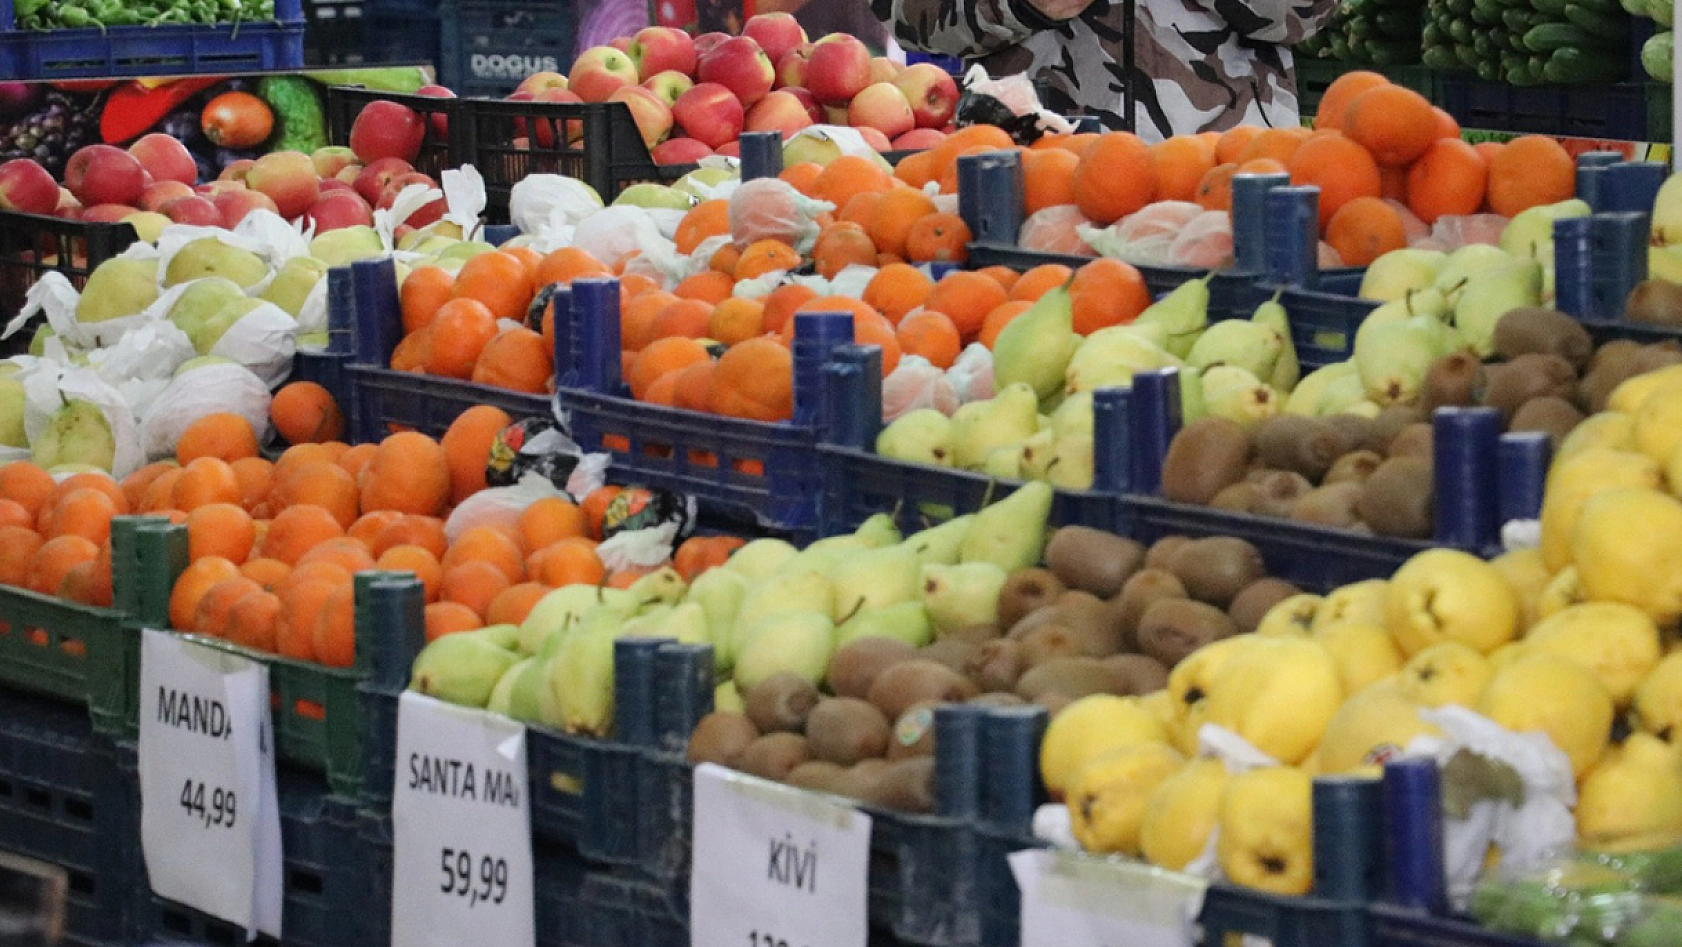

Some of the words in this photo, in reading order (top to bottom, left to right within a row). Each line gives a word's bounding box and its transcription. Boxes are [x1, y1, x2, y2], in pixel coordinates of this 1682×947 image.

[180, 779, 236, 828] 44,99
[409, 752, 476, 800] SANTA
[441, 847, 508, 908] 59,99
[768, 832, 816, 893] KİVİ
